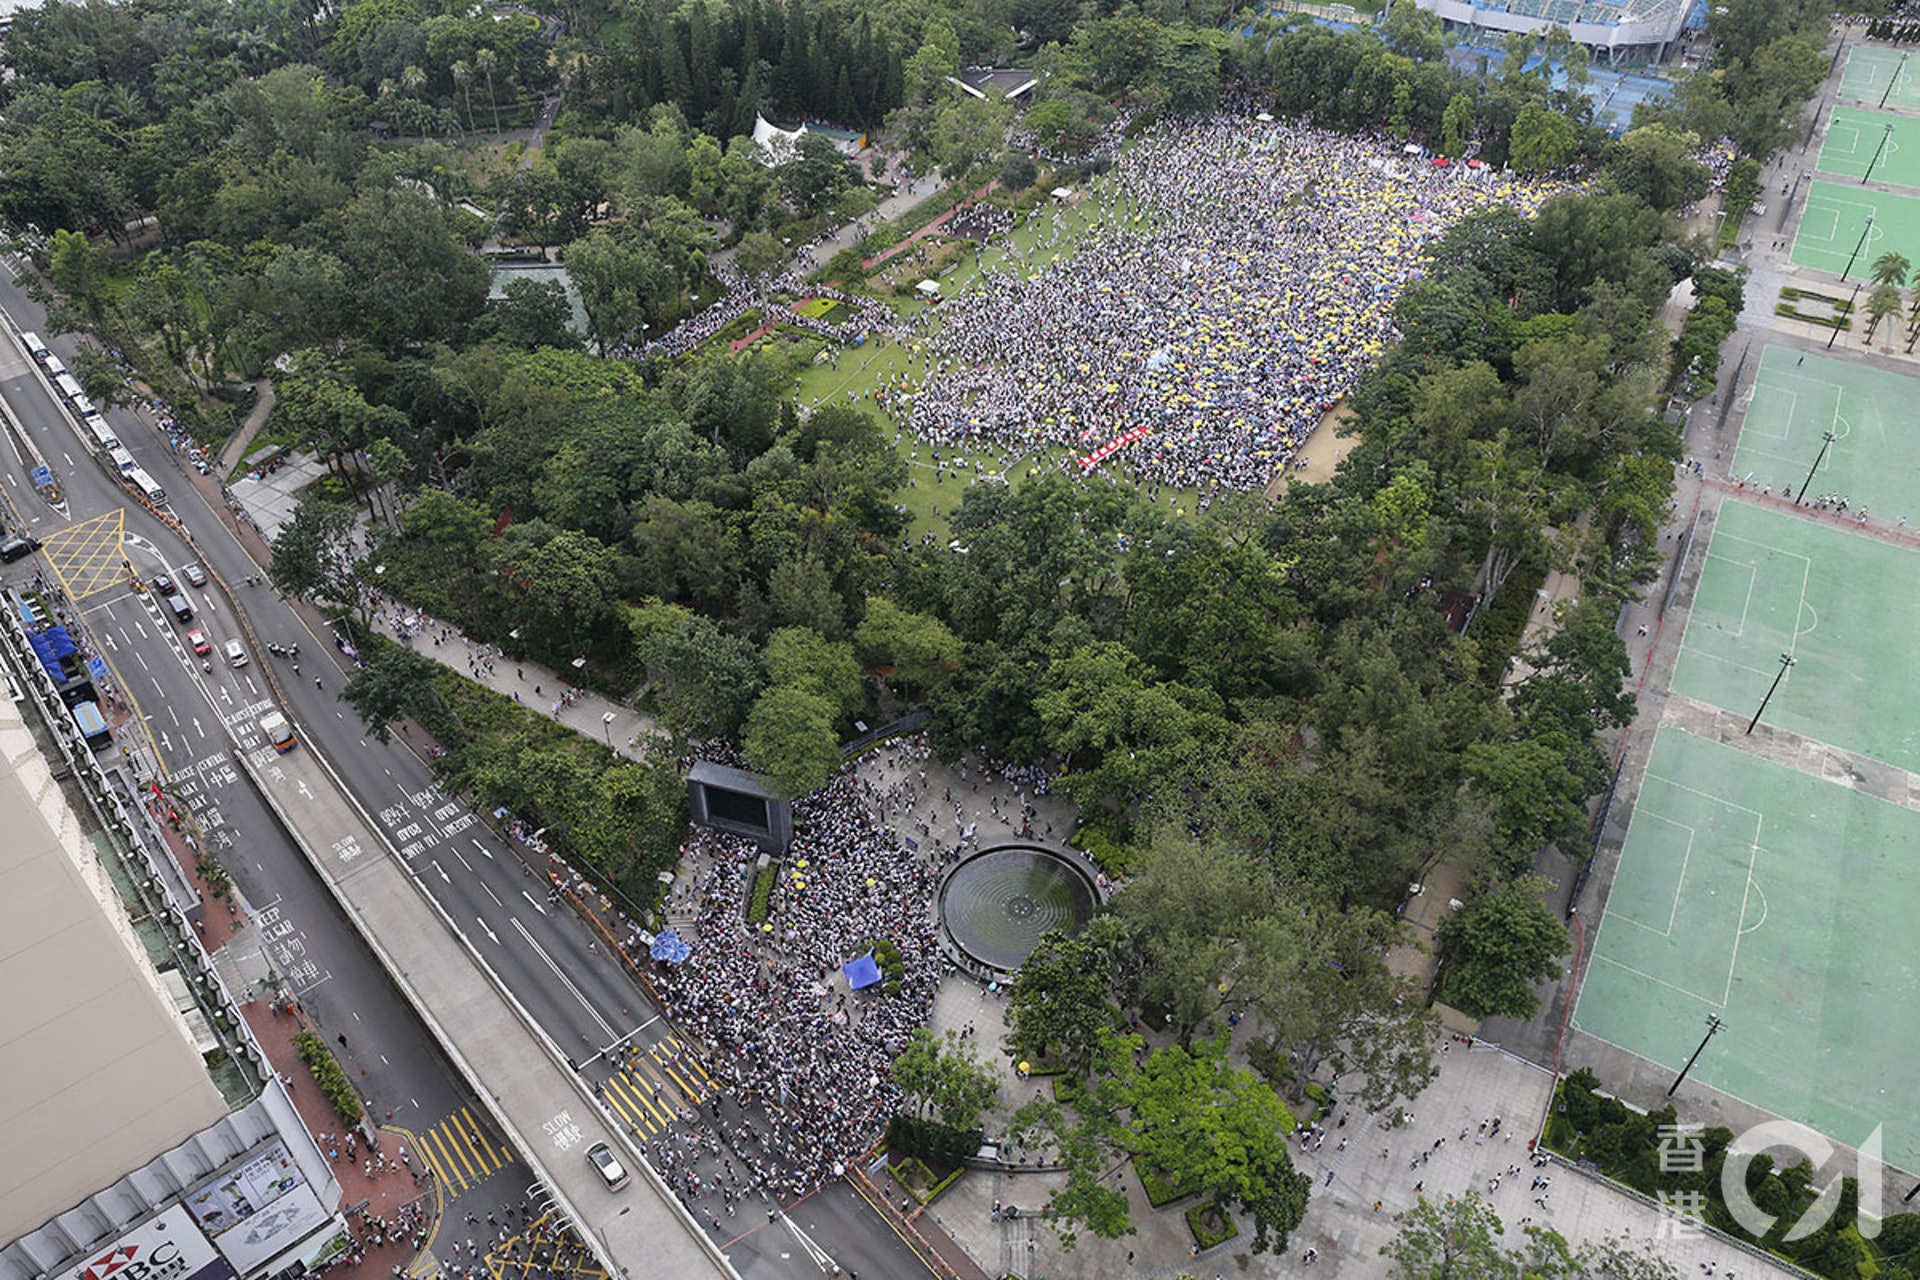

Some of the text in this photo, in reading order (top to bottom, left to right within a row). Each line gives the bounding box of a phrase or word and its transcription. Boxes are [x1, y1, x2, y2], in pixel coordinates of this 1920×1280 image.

[237, 722, 256, 736] WAY
[243, 735, 261, 750] BAY
[198, 752, 228, 771] CENTRAL
[210, 765, 239, 788] 中區
[180, 781, 199, 796] WAY
[188, 794, 208, 811] BAY
[435, 802, 460, 821] ROAD
[396, 822, 422, 841] ROAD
[441, 812, 479, 838] CAUSEWAY
[401, 833, 440, 860] TAI HANG
[258, 907, 280, 928] KEEP
[261, 919, 295, 945] CLEAR
[274, 937, 306, 966] 請勿
[290, 959, 320, 987] 停車
[542, 1109, 572, 1136] SLOW
